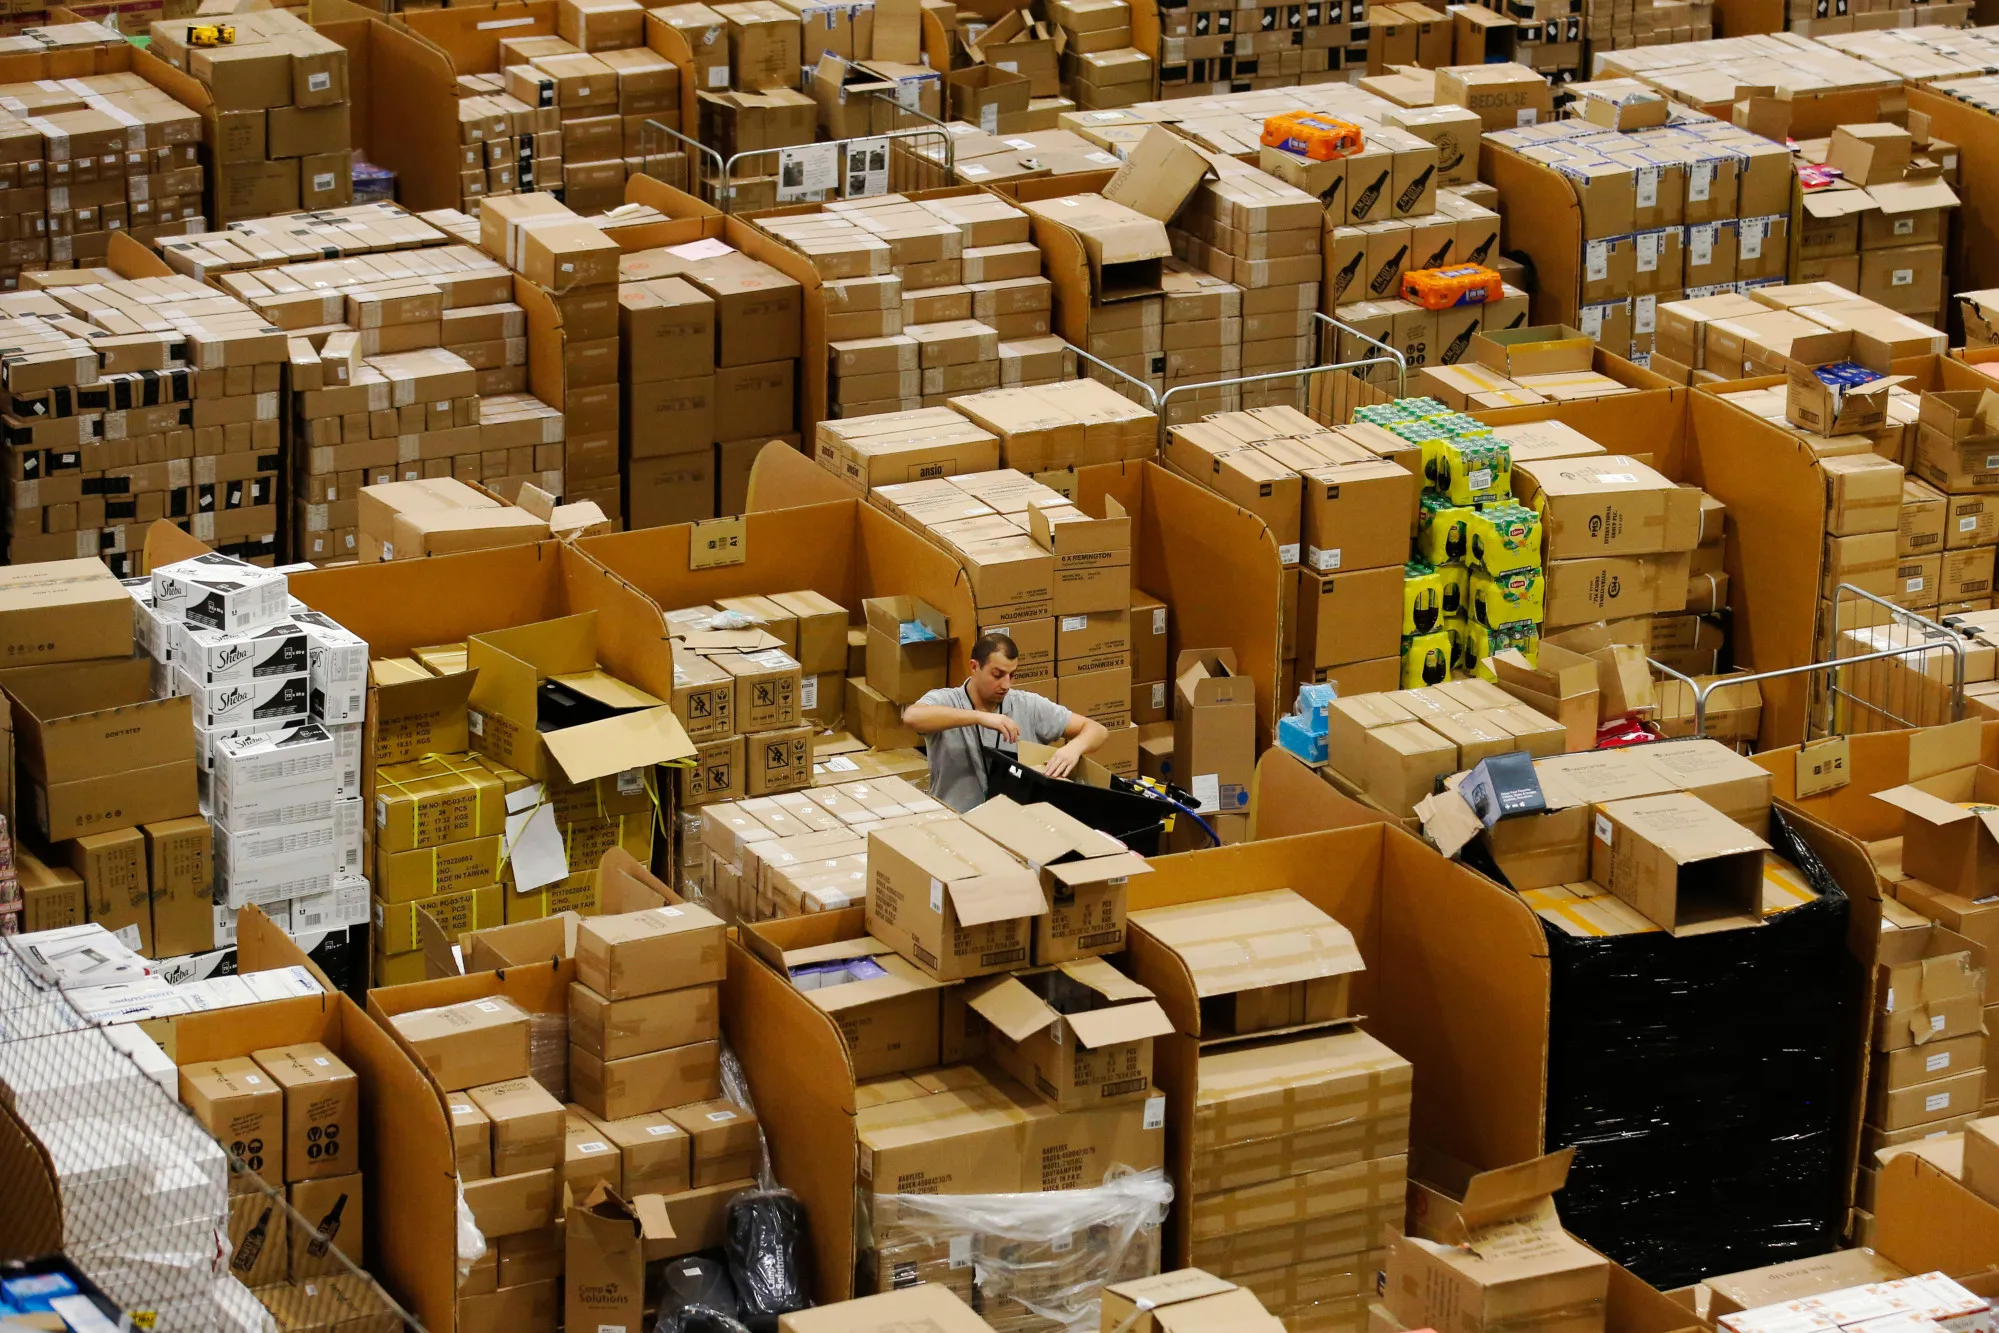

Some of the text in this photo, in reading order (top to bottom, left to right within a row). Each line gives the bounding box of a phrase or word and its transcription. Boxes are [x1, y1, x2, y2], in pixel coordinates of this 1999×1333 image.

[730, 536, 738, 546] A1
[1072, 552, 1112, 560] REMINGTON
[161, 580, 182, 597] Sheba
[1000, 610, 1036, 620] REMINGTON
[217, 650, 248, 669] Sheba
[1078, 661, 1113, 670] REMINGTON
[218, 692, 248, 712] Sheba
[105, 727, 142, 738] DON'T STEP
[464, 868, 490, 878] TAIWAN
[552, 905, 570, 914] MADE
[164, 968, 190, 985] Sheba
[1042, 1144, 1068, 1154] BABYLISS
[898, 1172, 925, 1182] BABYLISS
[1042, 1166, 1082, 1178] SOUTHAMPTON
[1042, 1178, 1056, 1186] MADE
[776, 1244, 785, 1290] Solutions
[579, 1284, 604, 1294] Camp
[580, 1293, 628, 1304] Solutions
